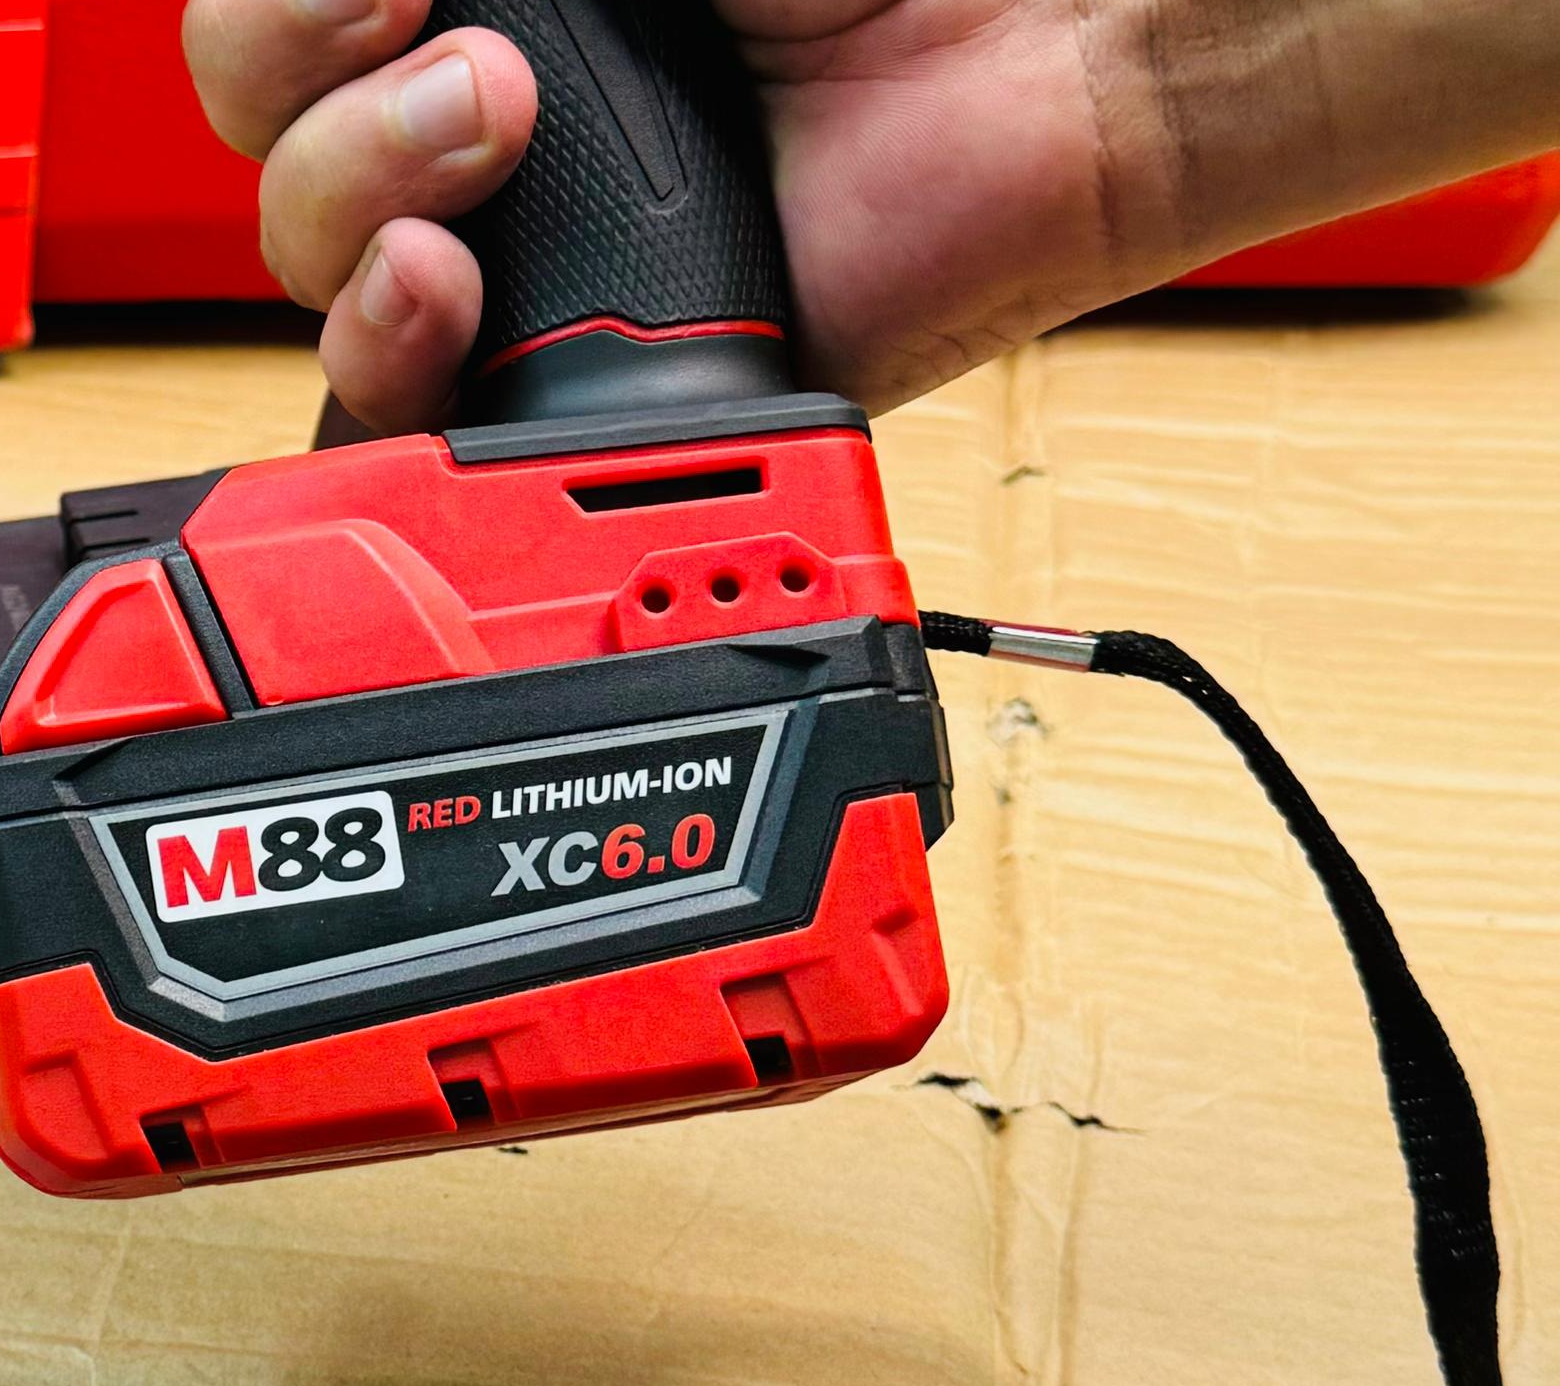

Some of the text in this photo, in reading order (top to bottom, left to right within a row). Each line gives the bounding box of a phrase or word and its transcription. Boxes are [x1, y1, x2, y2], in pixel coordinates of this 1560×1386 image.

[157, 756, 732, 908] M88 RED LITHIUM-ION
[492, 813, 715, 896] XC6.0
